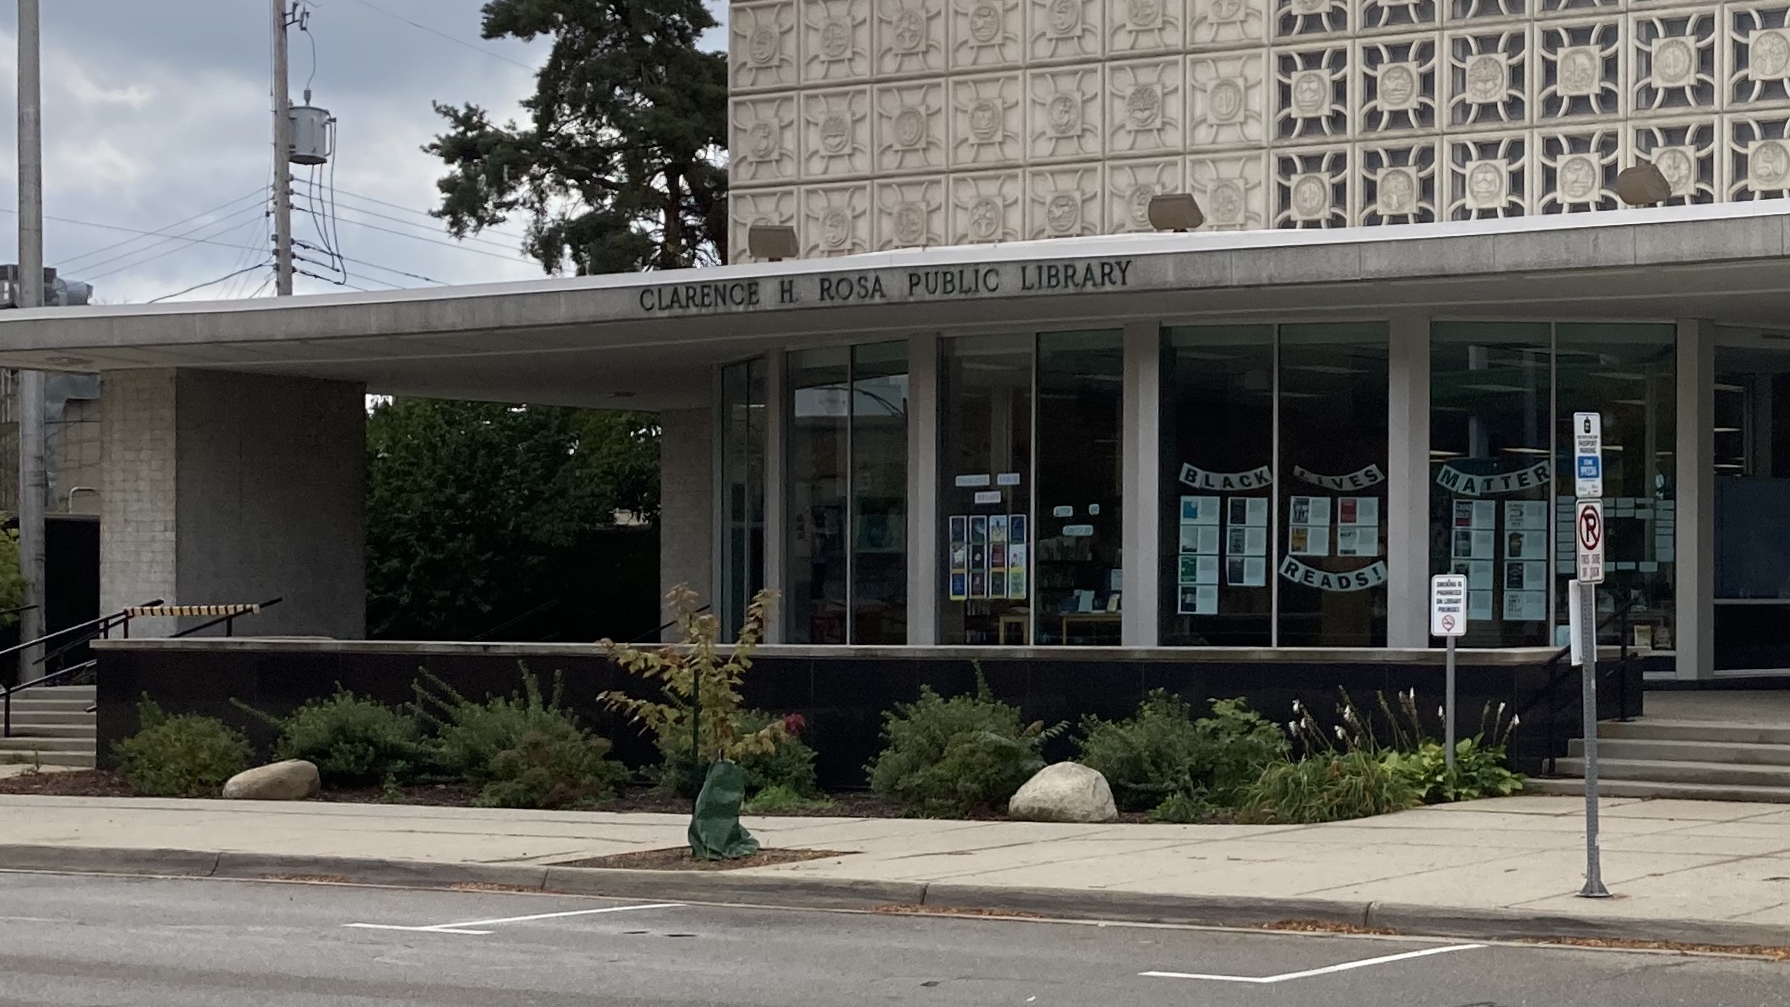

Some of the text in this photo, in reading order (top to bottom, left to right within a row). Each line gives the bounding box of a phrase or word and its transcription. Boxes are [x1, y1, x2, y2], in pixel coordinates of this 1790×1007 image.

[639, 282, 760, 312] CLARENCE
[818, 274, 886, 302] ROSA
[908, 268, 999, 296] PUBLIC
[1021, 260, 1132, 291] LIBRARY
[1184, 467, 1271, 490] BLACK
[1440, 465, 1550, 493] MATTER
[1283, 561, 1382, 590] READS!
